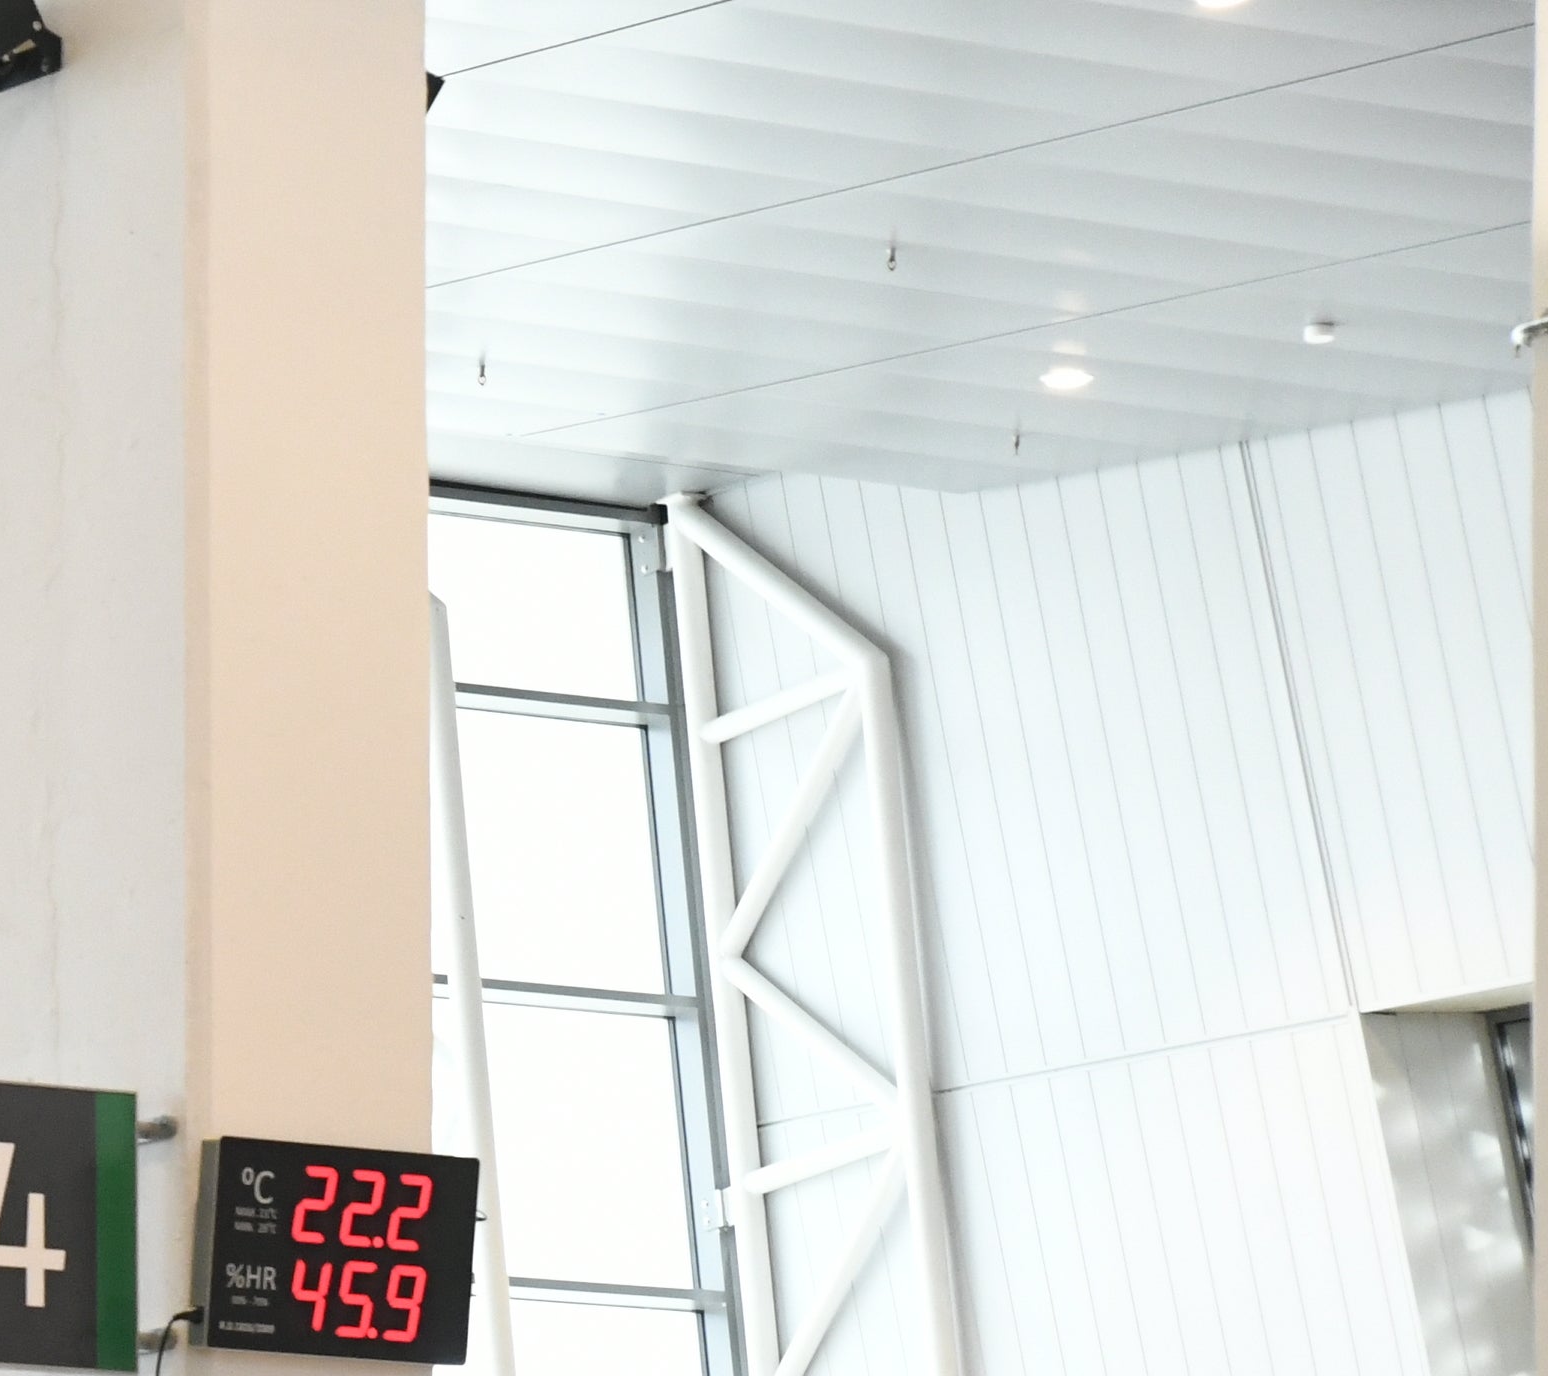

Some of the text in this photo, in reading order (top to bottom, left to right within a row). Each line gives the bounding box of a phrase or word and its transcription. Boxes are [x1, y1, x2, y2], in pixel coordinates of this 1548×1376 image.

[290, 1164, 434, 1253] 22.2
[225, 1258, 428, 1344] %HR 45.9
